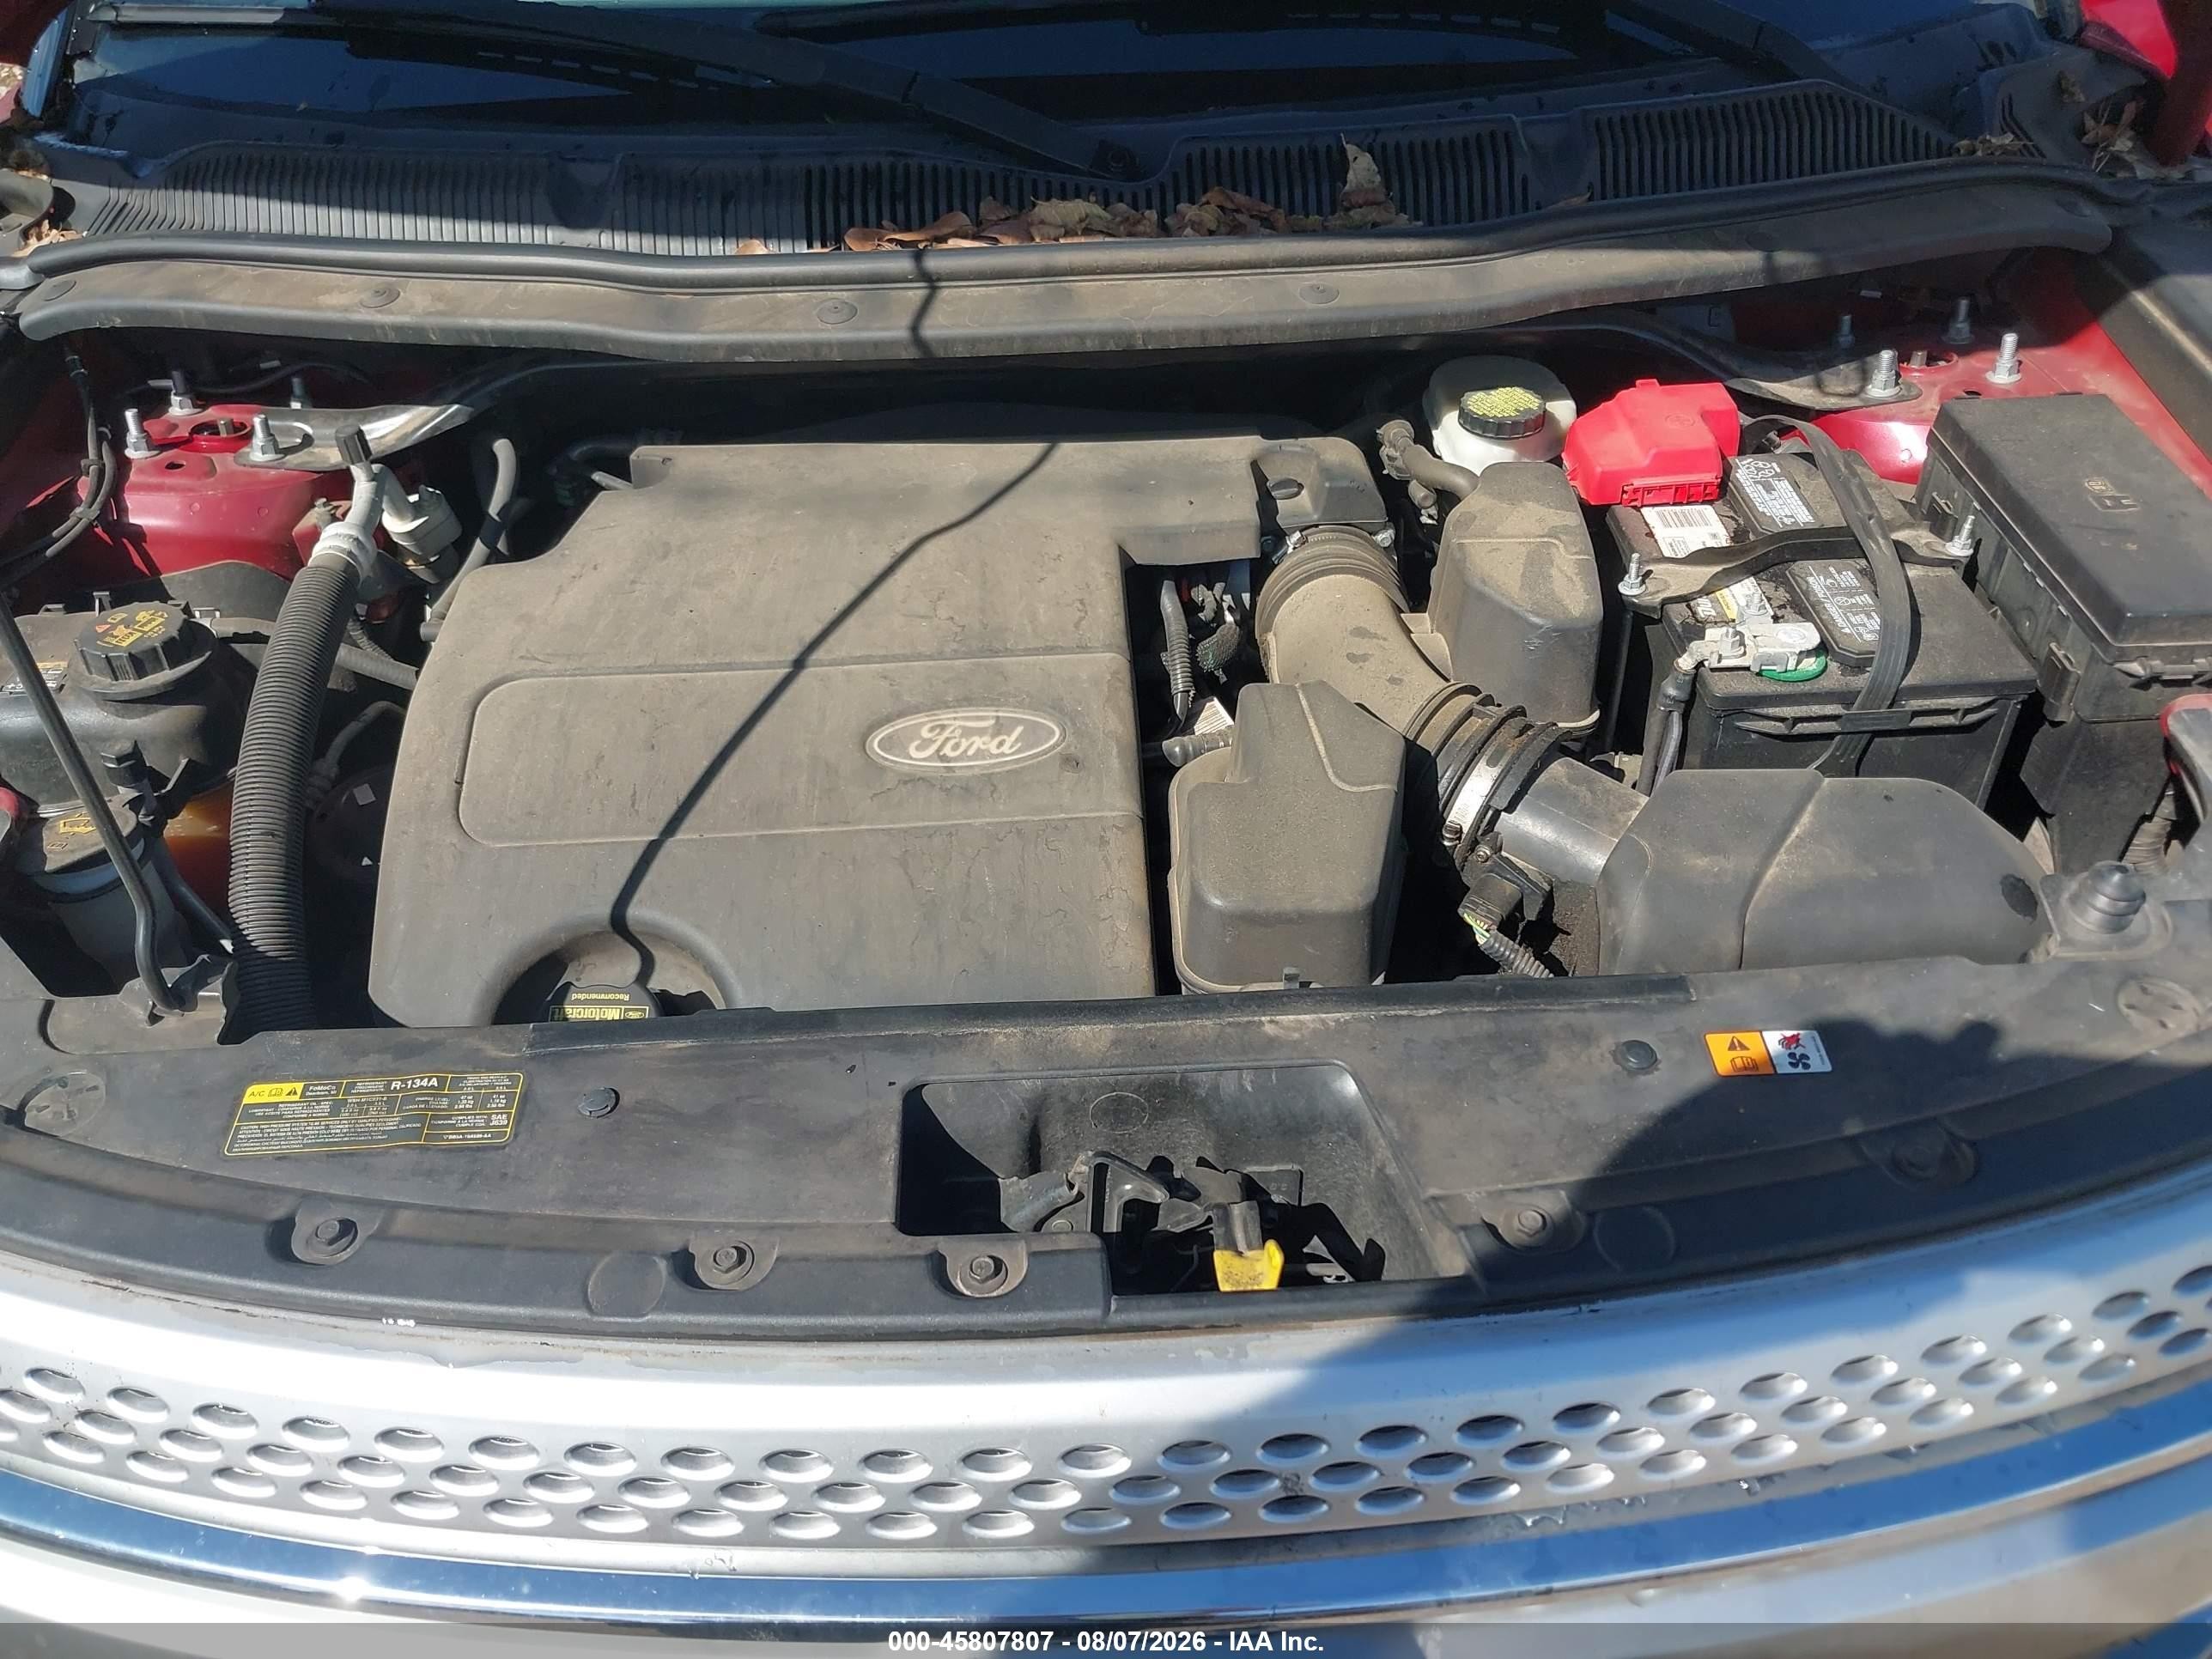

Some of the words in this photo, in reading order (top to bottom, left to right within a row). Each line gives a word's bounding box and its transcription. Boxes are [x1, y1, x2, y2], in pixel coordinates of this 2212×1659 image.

[908, 715, 1024, 759] Ford
[571, 993, 630, 1001] Recommended
[390, 1077, 438, 1091] R-134A
